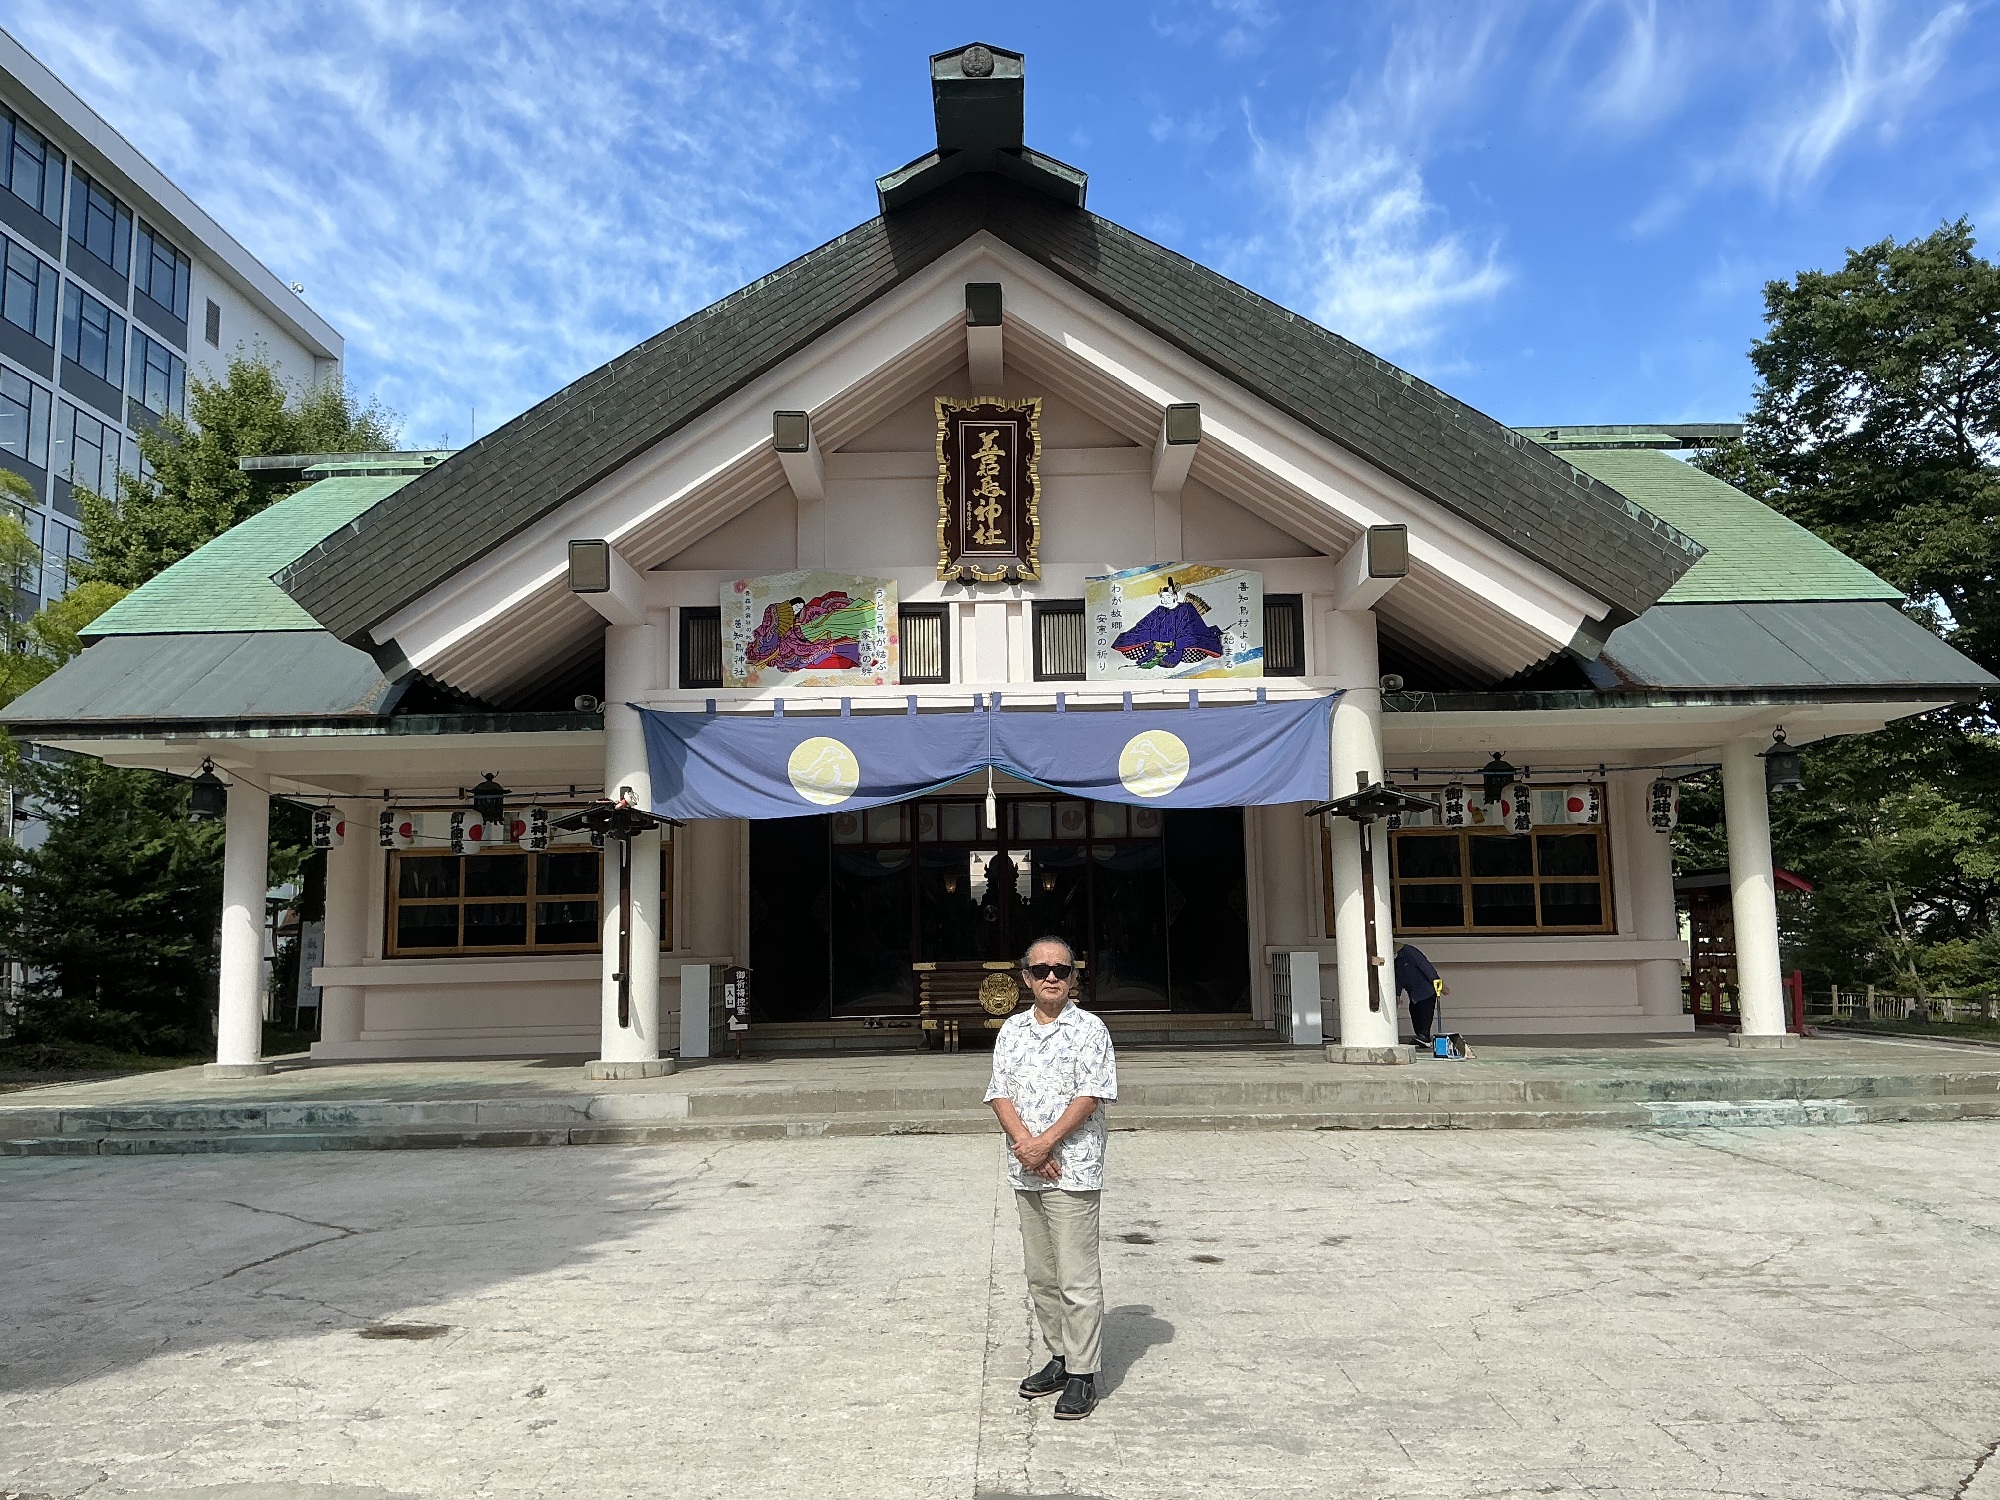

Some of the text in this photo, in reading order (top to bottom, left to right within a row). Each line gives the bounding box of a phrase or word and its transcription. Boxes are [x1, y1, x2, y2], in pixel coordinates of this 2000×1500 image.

[971, 430, 1007, 545] 善知鳥神社
[875, 589, 887, 671] うとう鳥が結ぶ
[1111, 584, 1123, 630] わが故郷
[1237, 581, 1249, 652] 善知鳥村より
[733, 619, 746, 676] 善知鳥神社
[860, 630, 873, 676] 家族の絆
[1096, 614, 1108, 671] 安寧の祈り
[1222, 635, 1235, 669] 始まる
[727, 990, 734, 1005] 入口
